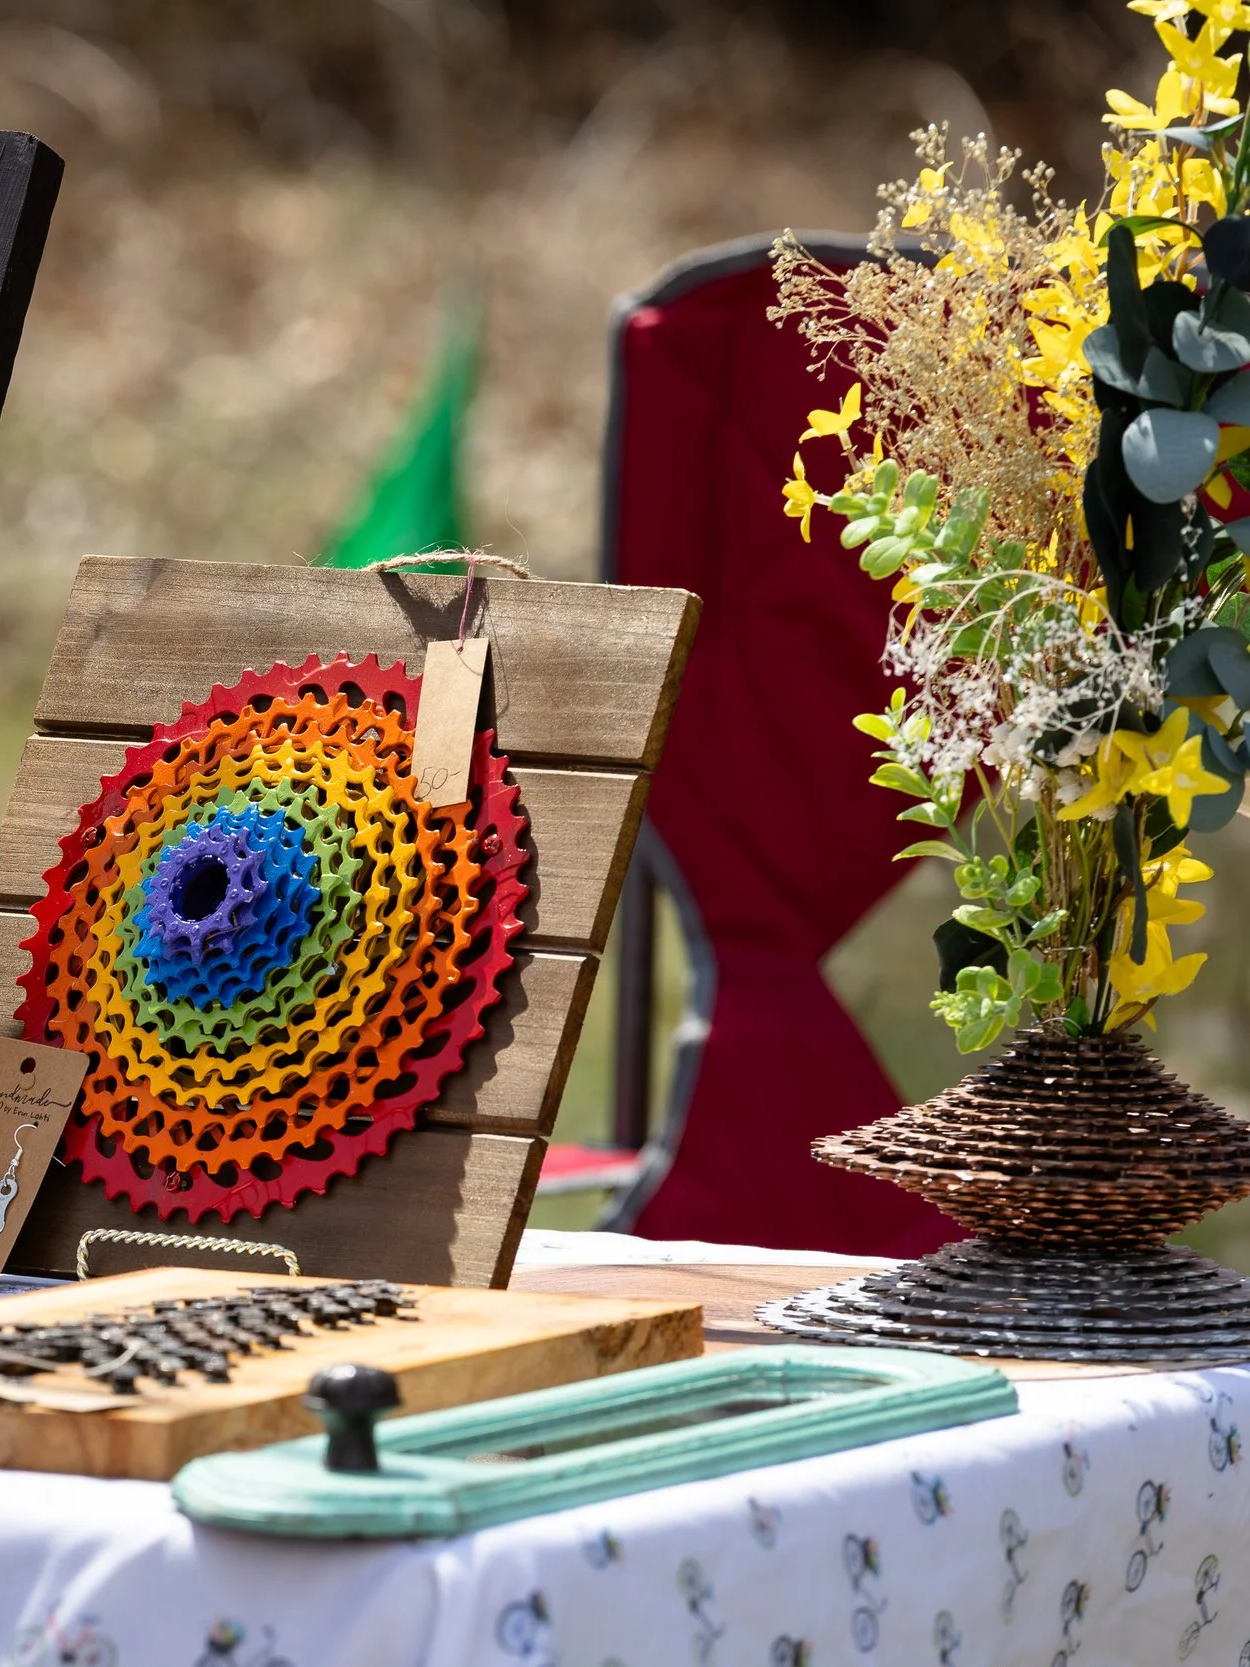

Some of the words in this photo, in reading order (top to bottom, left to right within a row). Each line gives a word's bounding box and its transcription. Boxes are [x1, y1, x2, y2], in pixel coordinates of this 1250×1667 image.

[4, 1105, 12, 1114] by
[13, 1107, 29, 1117] Erin
[30, 1111, 50, 1122] Lahti
